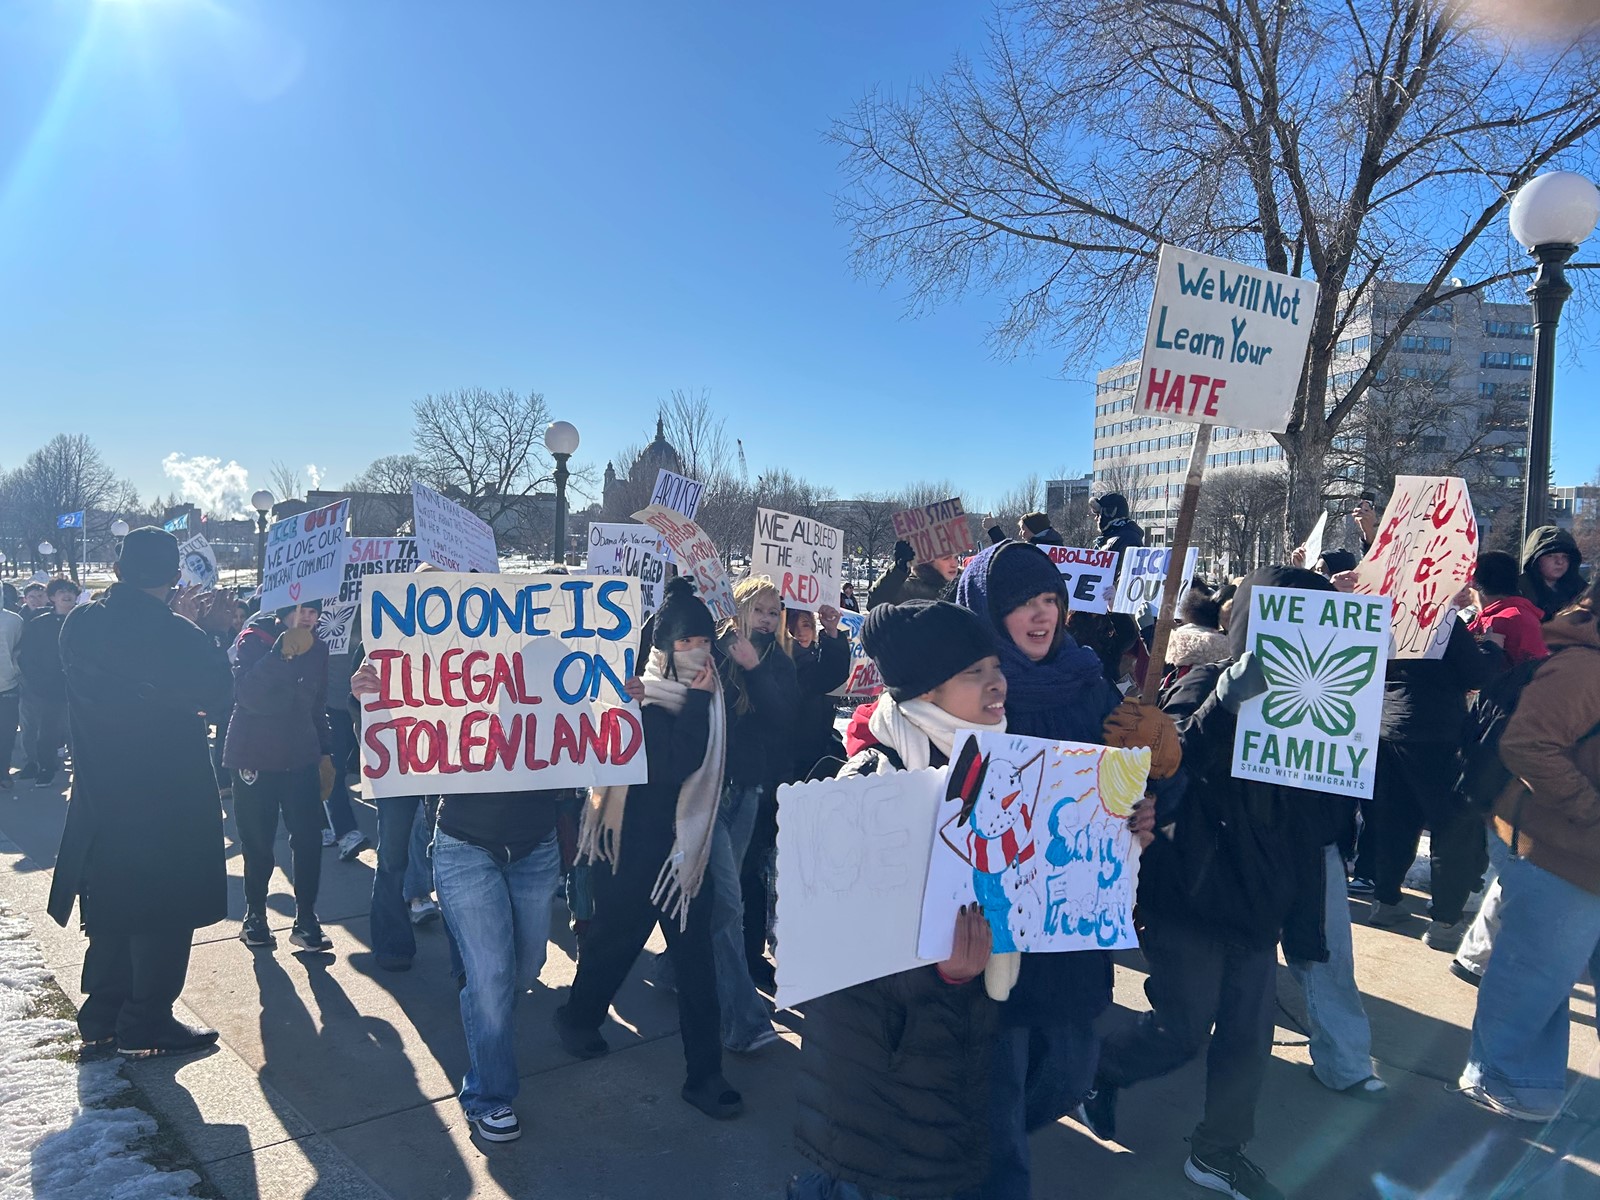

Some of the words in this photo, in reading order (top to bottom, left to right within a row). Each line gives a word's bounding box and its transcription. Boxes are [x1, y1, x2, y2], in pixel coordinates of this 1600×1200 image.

[1178, 263, 1215, 300] We
[1219, 270, 1262, 312] Will
[1262, 280, 1301, 326] Not
[1156, 305, 1225, 360] Learn
[1230, 316, 1273, 366] Your
[1144, 367, 1227, 417] HATE
[416, 486, 441, 509] ANNE
[652, 473, 702, 519] ABOLISH
[269, 516, 298, 547] ICE
[304, 501, 349, 533] OUT!
[428, 523, 441, 535] HER
[757, 510, 789, 543] WE
[790, 519, 813, 546] ALL
[814, 522, 838, 551] BLEED
[892, 507, 926, 536] END
[925, 497, 965, 525] STATE
[267, 553, 282, 571] WE
[286, 534, 317, 563] LOVE
[318, 527, 342, 548] OUR
[349, 539, 394, 563] SALT
[591, 526, 618, 547] Obama
[908, 516, 975, 564] IOLENCE
[296, 550, 336, 578] COMMUNITY
[344, 559, 384, 581] ROADS
[429, 549, 460, 572] HISTORY
[761, 542, 793, 568] THE
[811, 550, 833, 579] SAME
[1048, 547, 1115, 568] ABOLISH
[323, 597, 337, 607] WE
[339, 580, 362, 603] OFF
[780, 571, 819, 604] RED
[371, 583, 452, 639] NO
[457, 583, 552, 638] ONE
[560, 581, 632, 641] IS
[1258, 594, 1306, 624] WE
[1319, 599, 1383, 633] ARE
[364, 648, 542, 712] ILLEGAL
[363, 710, 522, 779] STOLEN
[524, 708, 643, 770] LAND
[1242, 730, 1369, 779] FAMILY
[1241, 762, 1271, 775] STAND
[1276, 769, 1299, 779] WITH
[1303, 773, 1365, 790] IMMIGRANTS
